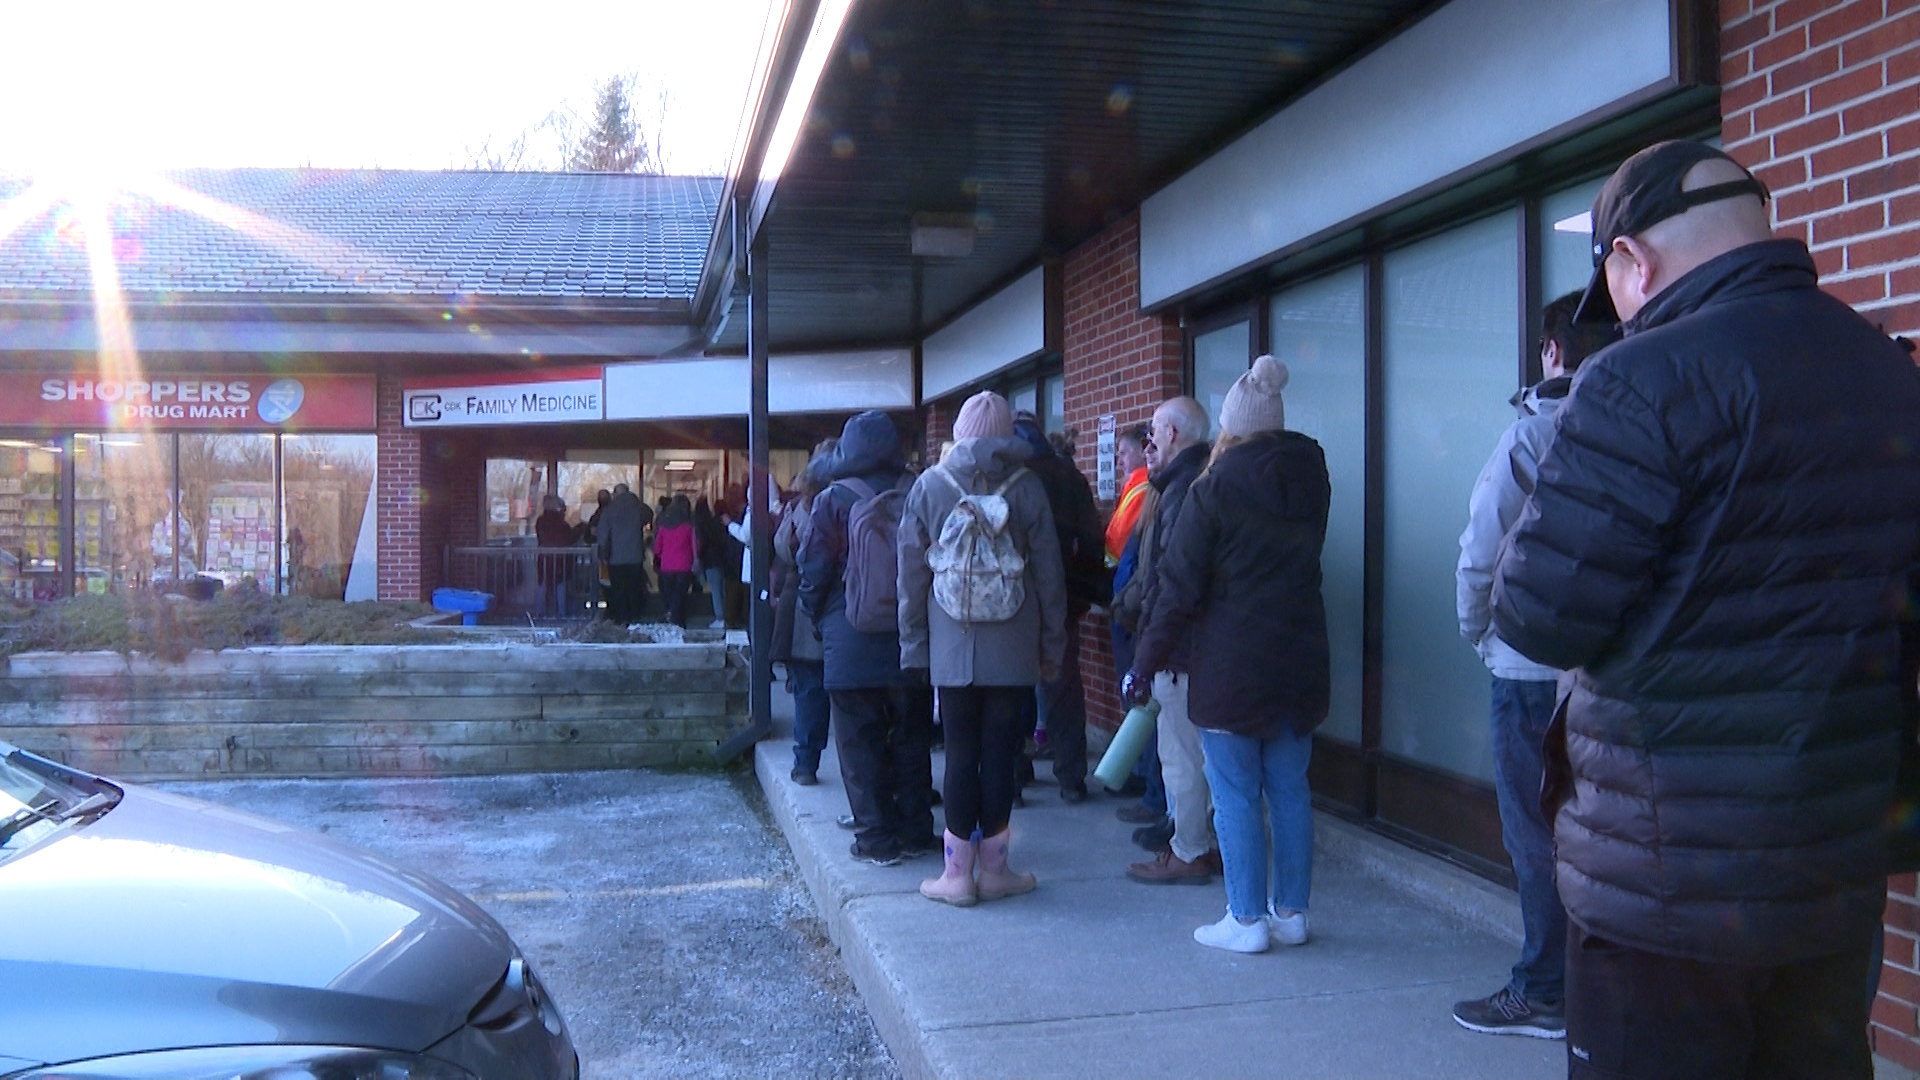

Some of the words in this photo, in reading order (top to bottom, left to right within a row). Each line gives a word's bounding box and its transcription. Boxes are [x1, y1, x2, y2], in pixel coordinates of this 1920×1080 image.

[41, 379, 251, 402] SHOPPERS
[123, 405, 184, 419] DRUG
[189, 404, 250, 418] MART
[466, 396, 518, 415] FAMILY
[521, 393, 597, 412] MEDICINE
